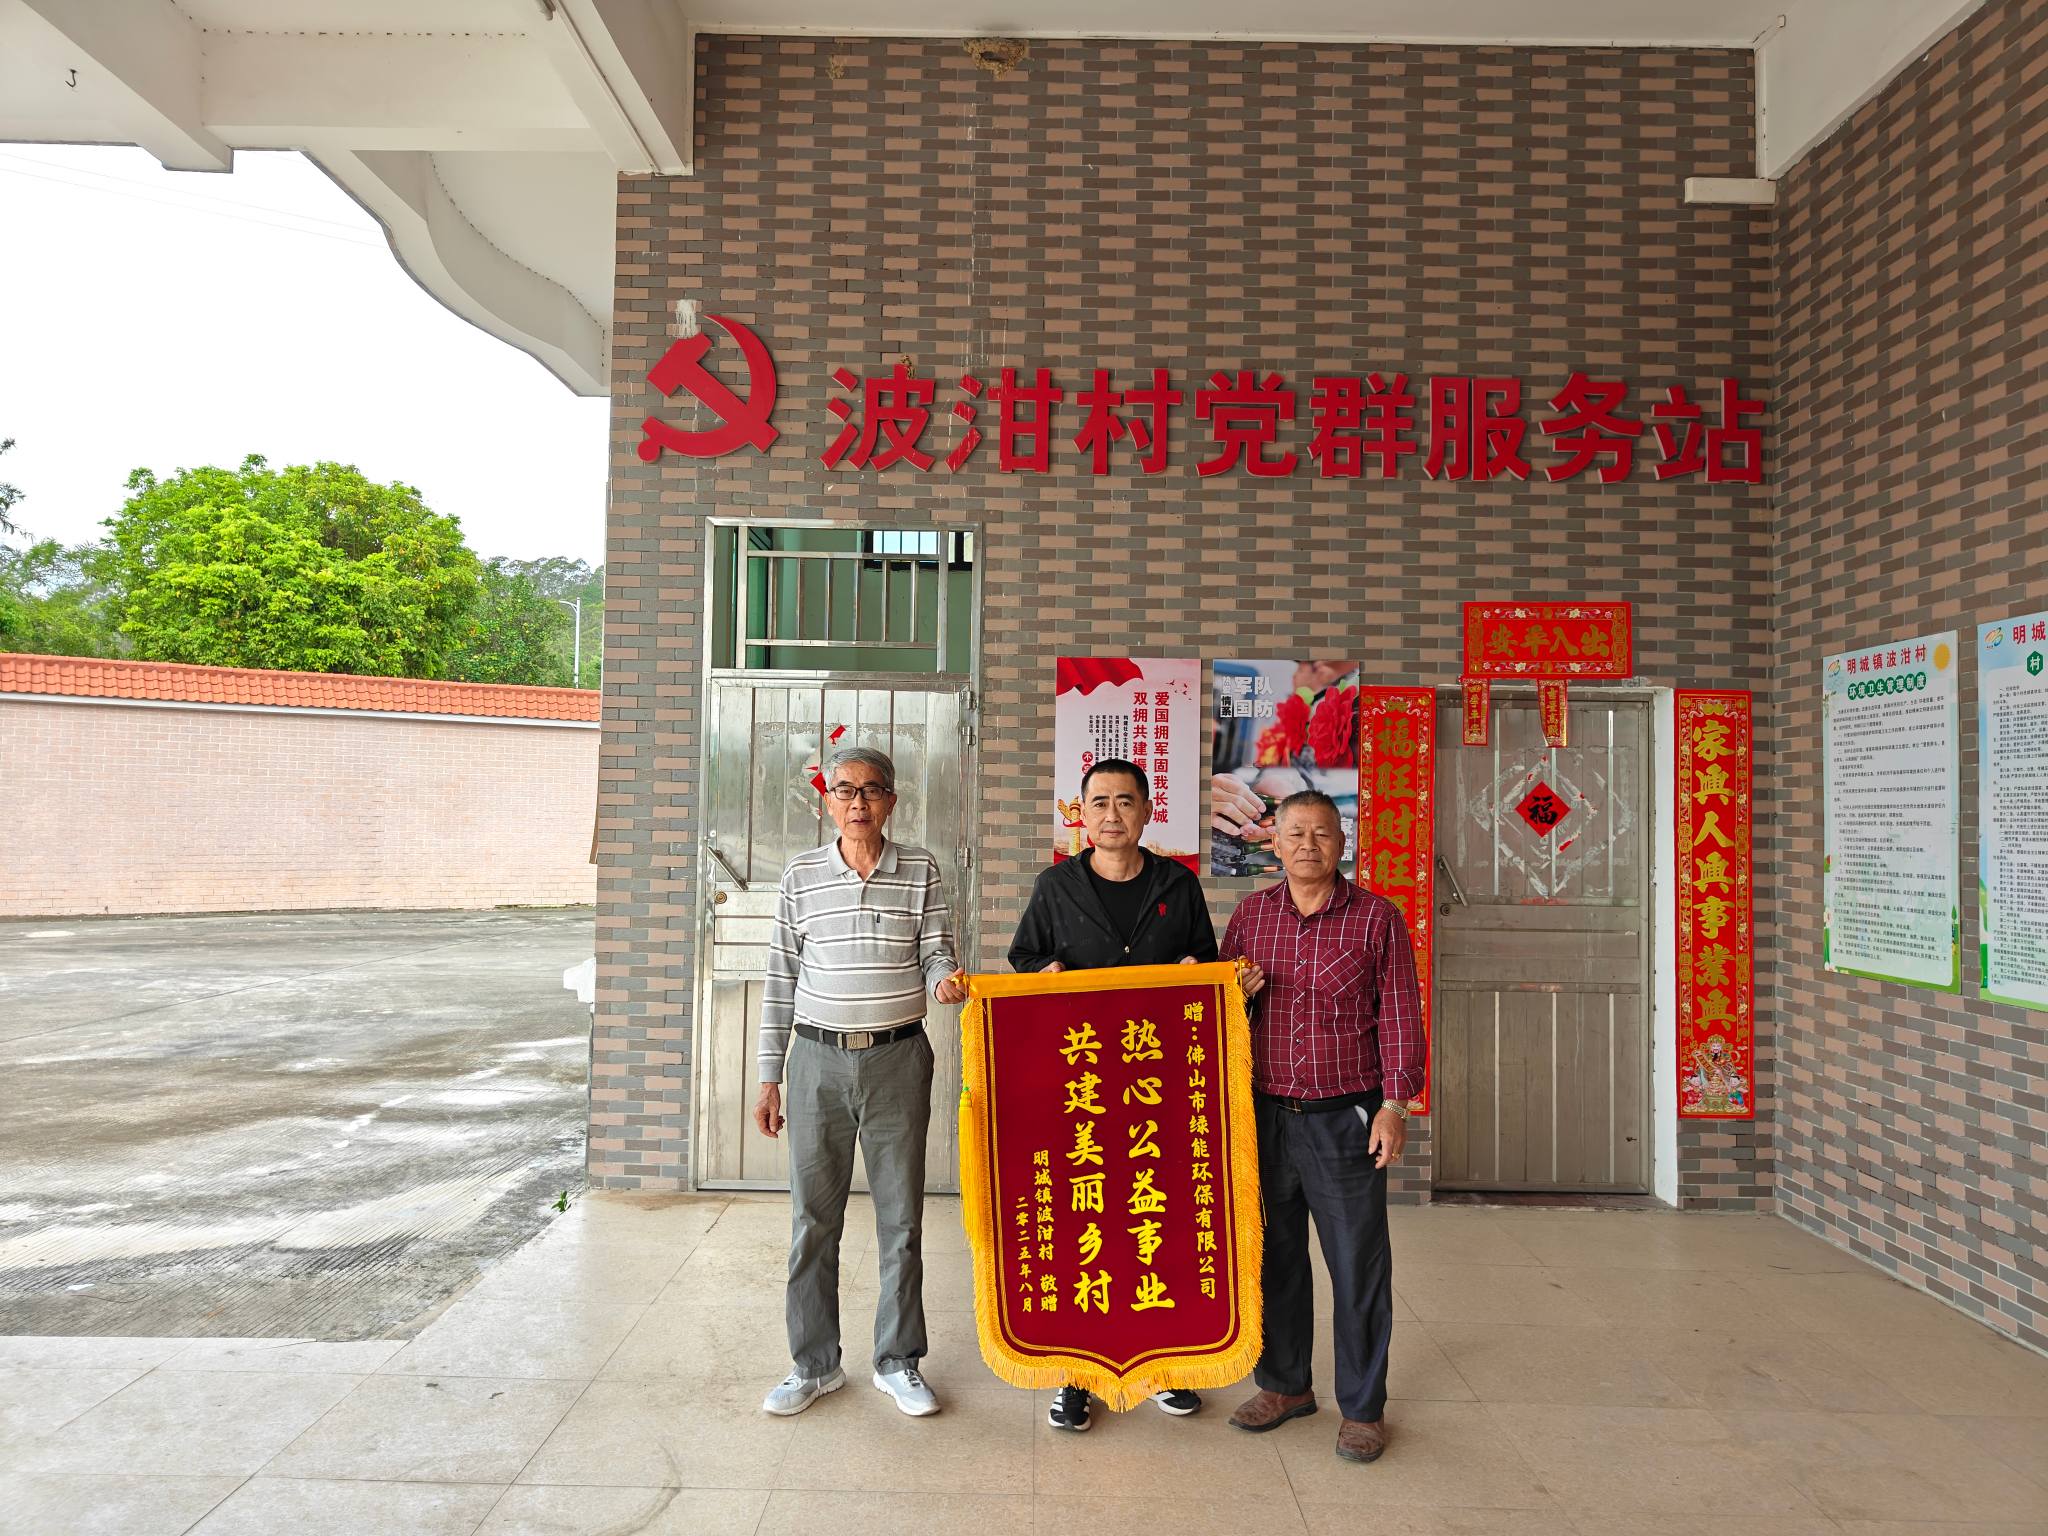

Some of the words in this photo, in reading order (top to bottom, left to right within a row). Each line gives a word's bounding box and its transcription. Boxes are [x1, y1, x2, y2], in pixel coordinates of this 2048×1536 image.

[819, 363, 1766, 485] 波泔村党群服务站
[1488, 623, 1611, 657] 出入平安
[1847, 643, 1927, 674] 明城镇波泔村
[1848, 673, 1927, 699] 环境卫生管理制度
[2013, 621, 2046, 644] 明城
[1153, 691, 1170, 823] 爱国拥军固我长城
[1527, 795, 1558, 825] 福
[1033, 1149, 1055, 1262] 明城镇波泔村
[1058, 1021, 1113, 1315] 共建美丽乡村
[1120, 1019, 1176, 1313] 热心公益事业
[1183, 1001, 1217, 1300] 赠：佛山市绿能环保有限公司
[1015, 1196, 1034, 1314] 二零二五年八月
[1040, 1273, 1058, 1313] 敬赠
